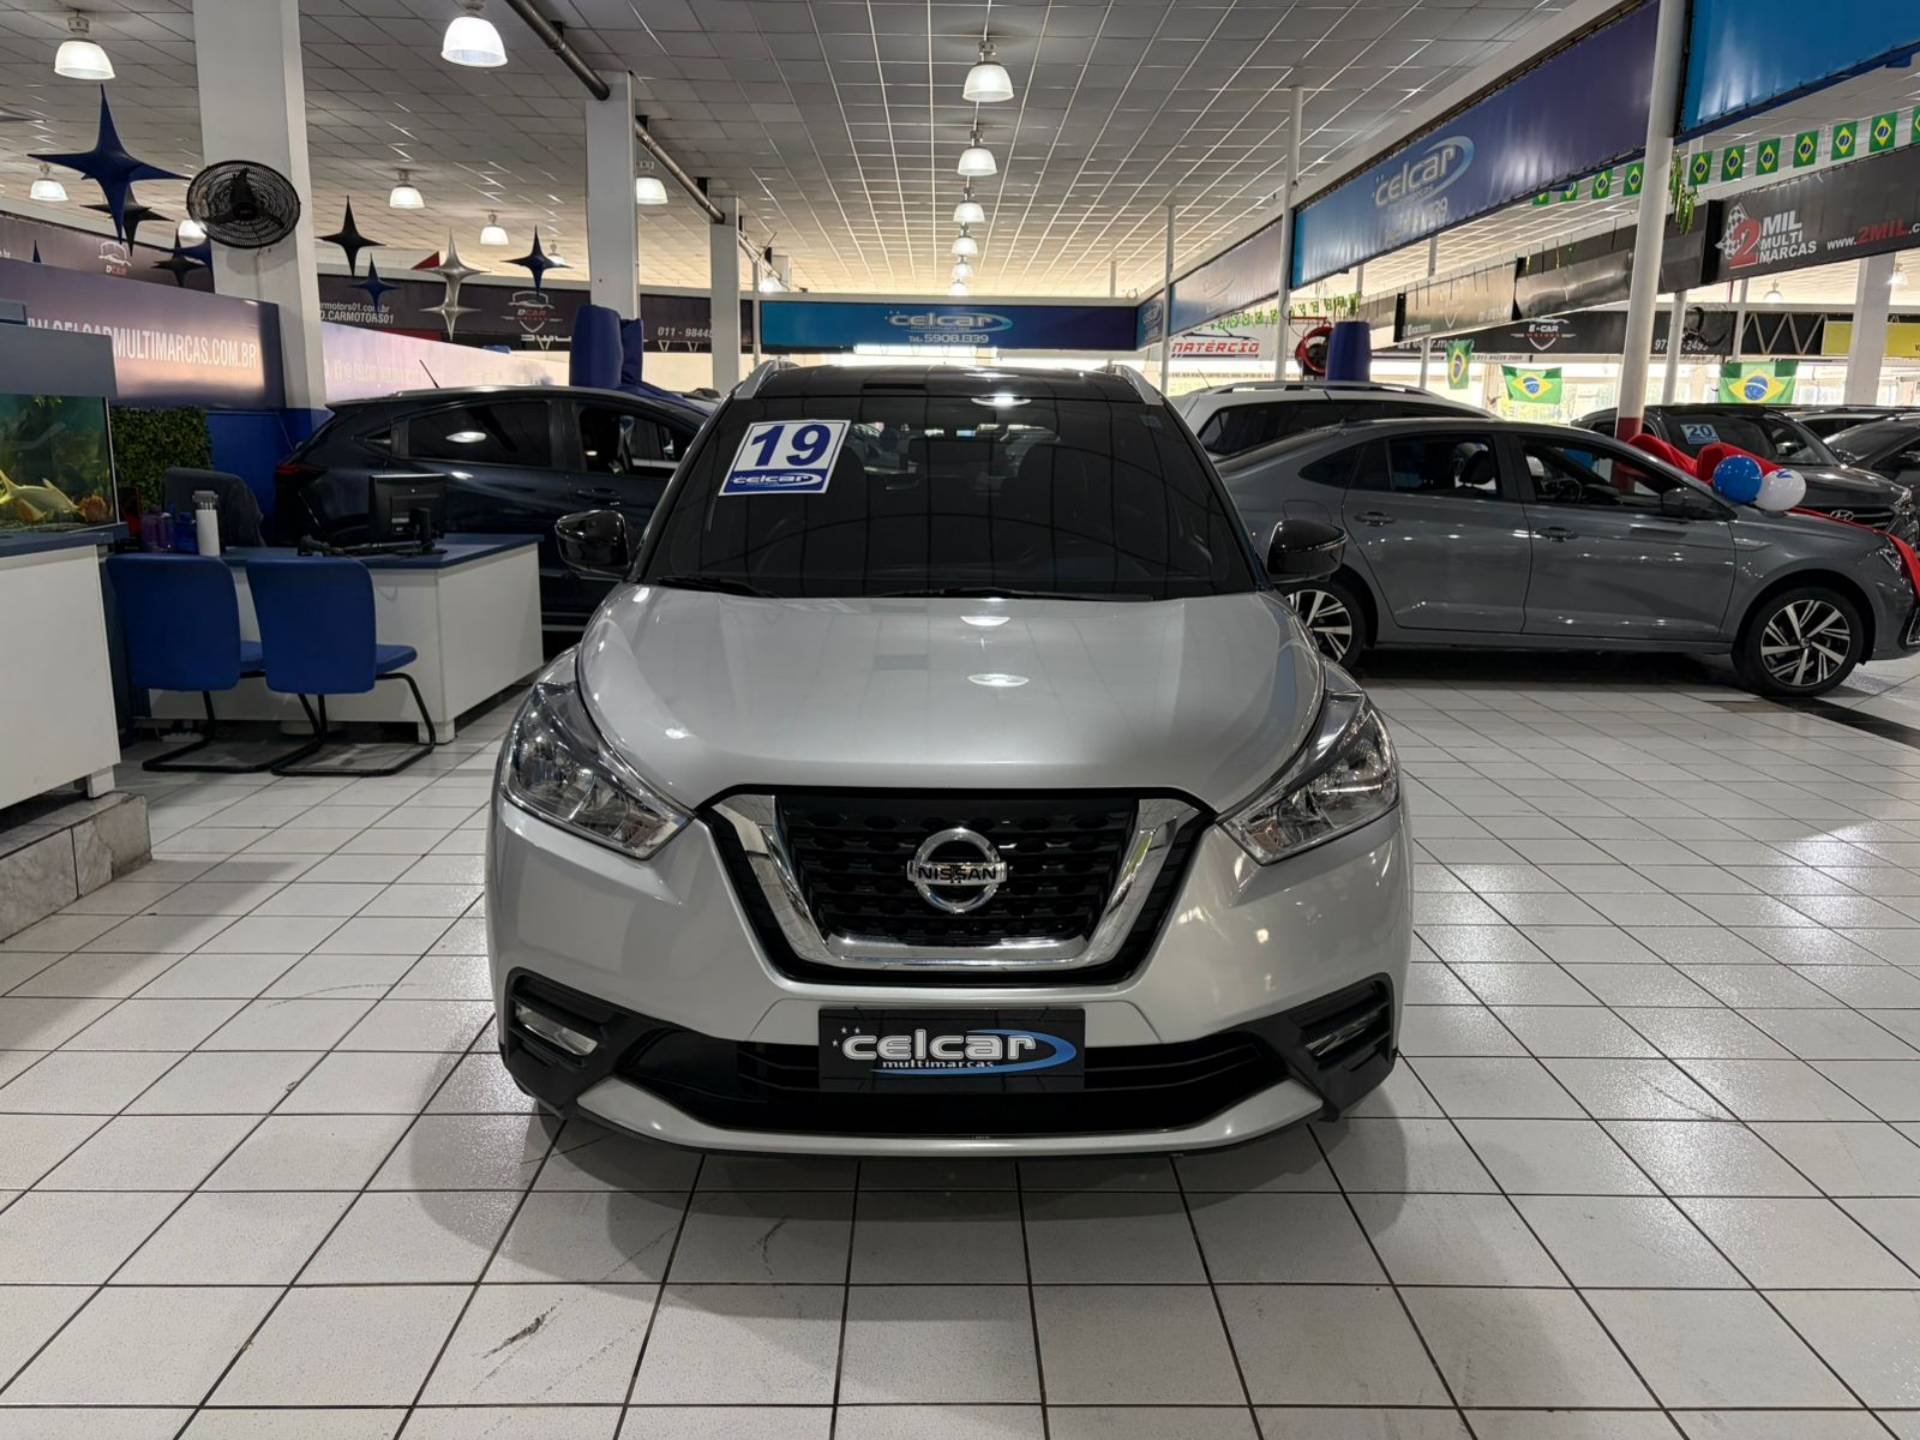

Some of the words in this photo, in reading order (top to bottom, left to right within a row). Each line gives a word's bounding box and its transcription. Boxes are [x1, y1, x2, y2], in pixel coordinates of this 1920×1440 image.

[1375, 146, 1456, 207] celcar
[1762, 211, 1803, 236] MIL
[1761, 231, 1803, 249] MULTI
[1759, 241, 1818, 263] MARCAS
[889, 313, 992, 327] celcar
[657, 327, 676, 337] 011
[1686, 425, 1713, 437] 20
[751, 424, 831, 467] 19
[917, 865, 997, 881] NISSAN
[842, 1028, 1037, 1061] celcar
[882, 1059, 995, 1069] multimarcas
